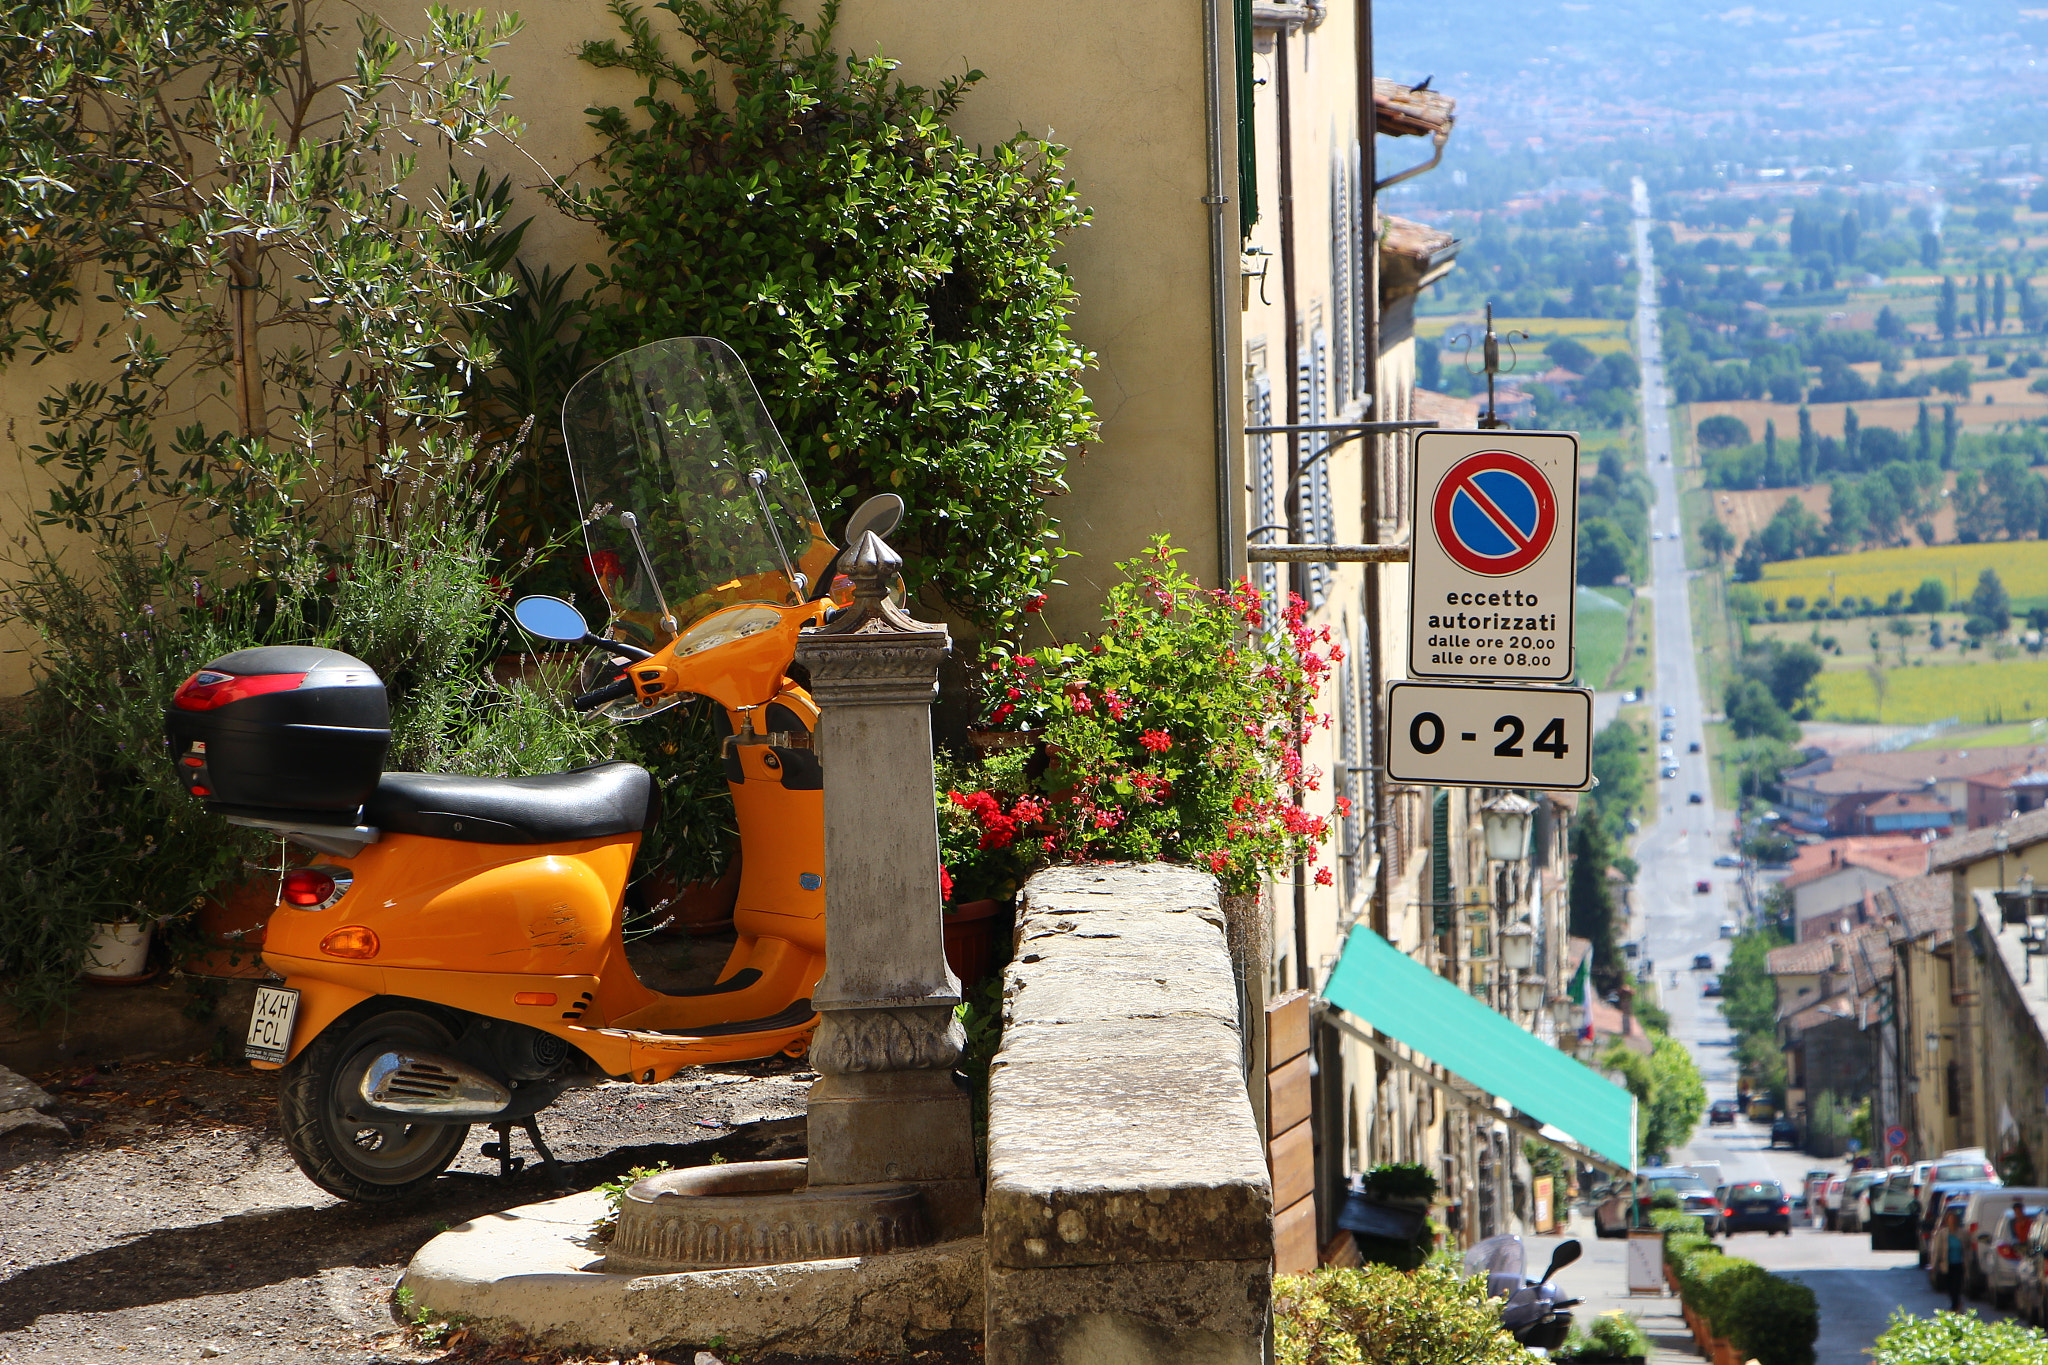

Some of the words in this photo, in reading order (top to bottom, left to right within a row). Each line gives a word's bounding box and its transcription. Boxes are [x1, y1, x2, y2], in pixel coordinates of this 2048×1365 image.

[1447, 590, 1538, 607] eccetto
[1428, 612, 1556, 631] autorizzati
[1428, 634, 1471, 648] dalle
[1476, 638, 1504, 648] ore
[1509, 636, 1556, 650] 20.00
[1431, 652, 1464, 664] alle
[1469, 655, 1497, 665] ore
[1504, 653, 1551, 667] 08.00
[1493, 715, 1569, 760] 24
[258, 992, 290, 1019] X4H
[252, 1018, 281, 1046] FCL
